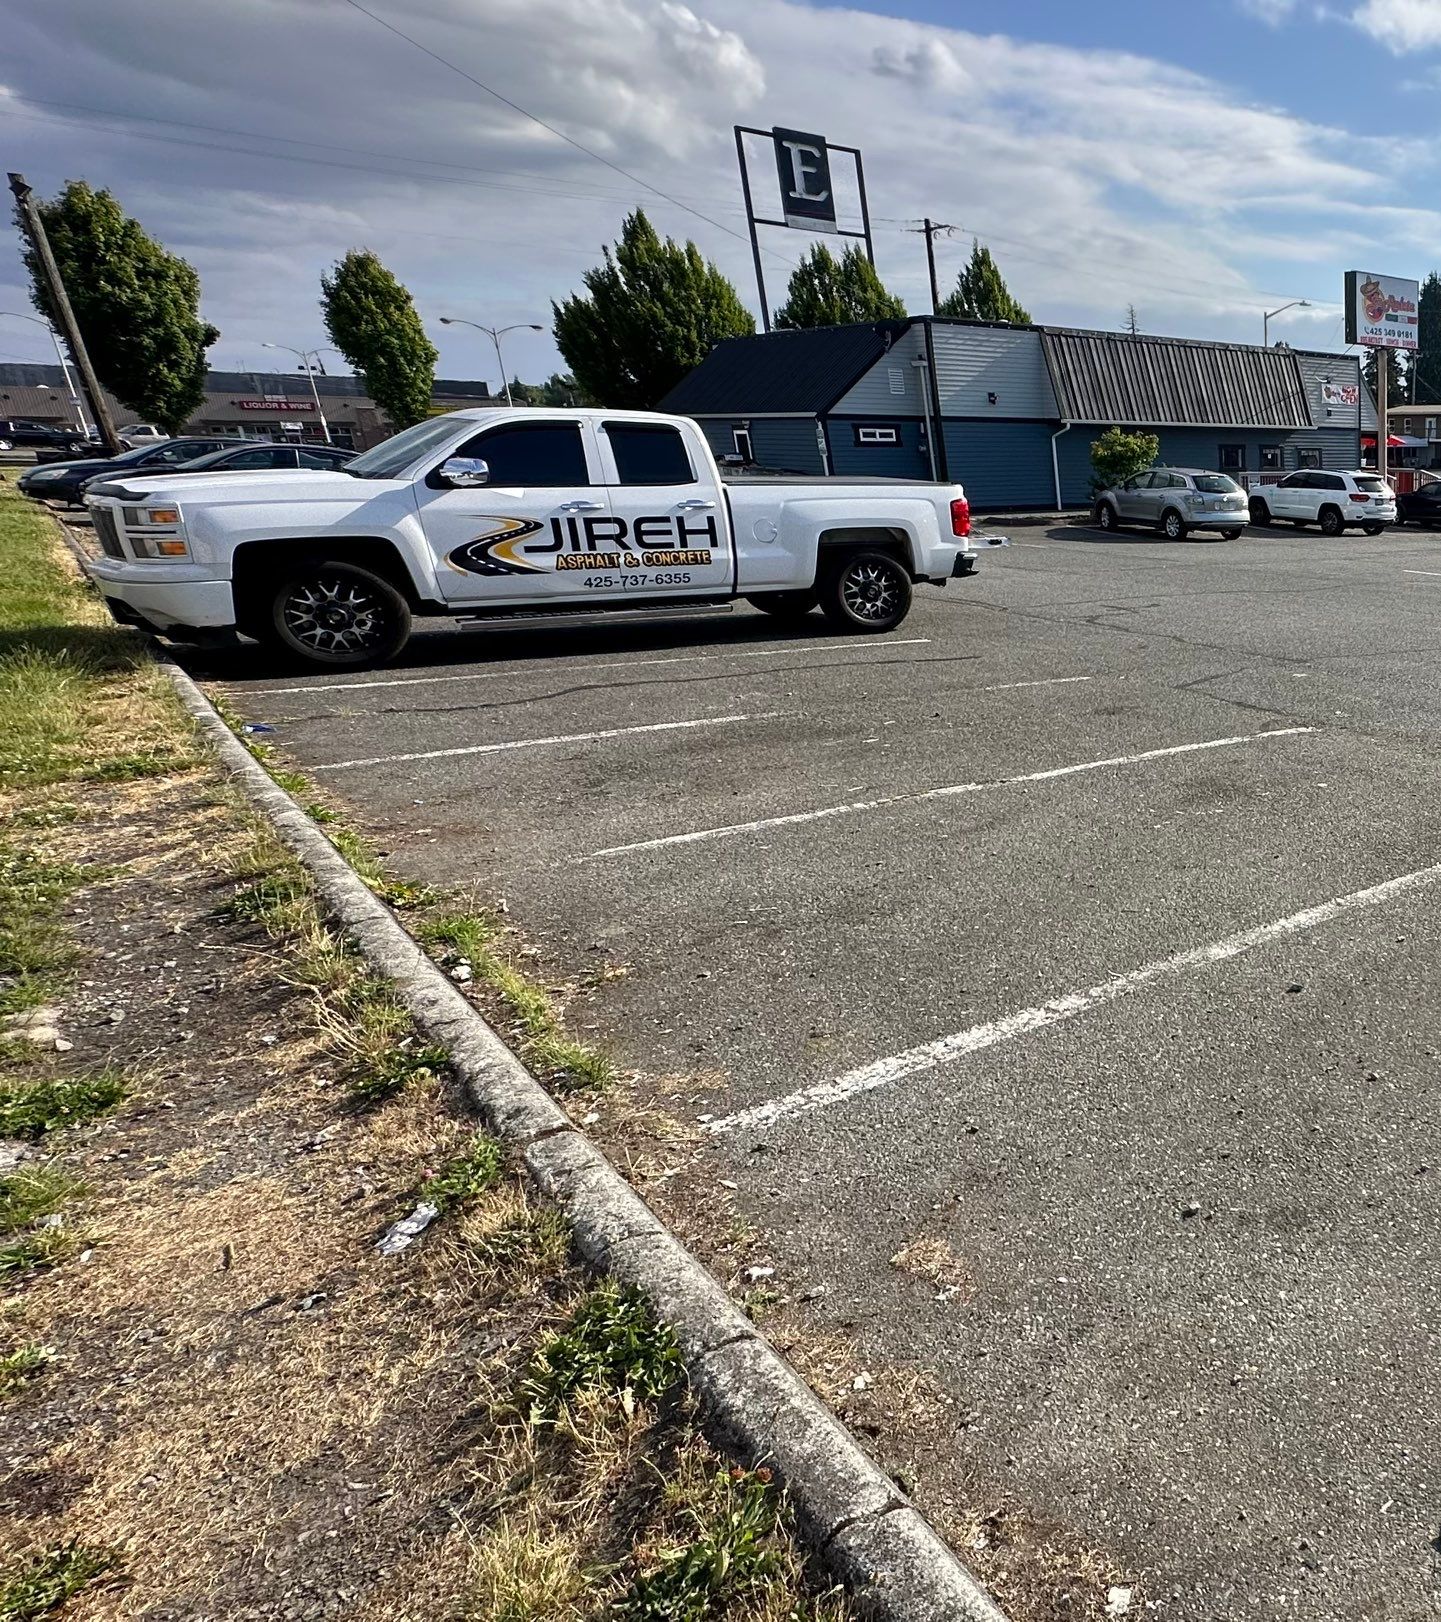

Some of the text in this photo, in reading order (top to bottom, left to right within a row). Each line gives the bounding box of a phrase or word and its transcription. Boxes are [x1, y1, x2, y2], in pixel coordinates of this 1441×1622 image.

[782, 140, 829, 202] E
[523, 515, 718, 554] JIREH
[556, 550, 712, 571] ASPHALT & CONCRETE
[584, 572, 691, 588] 425-737-6355
